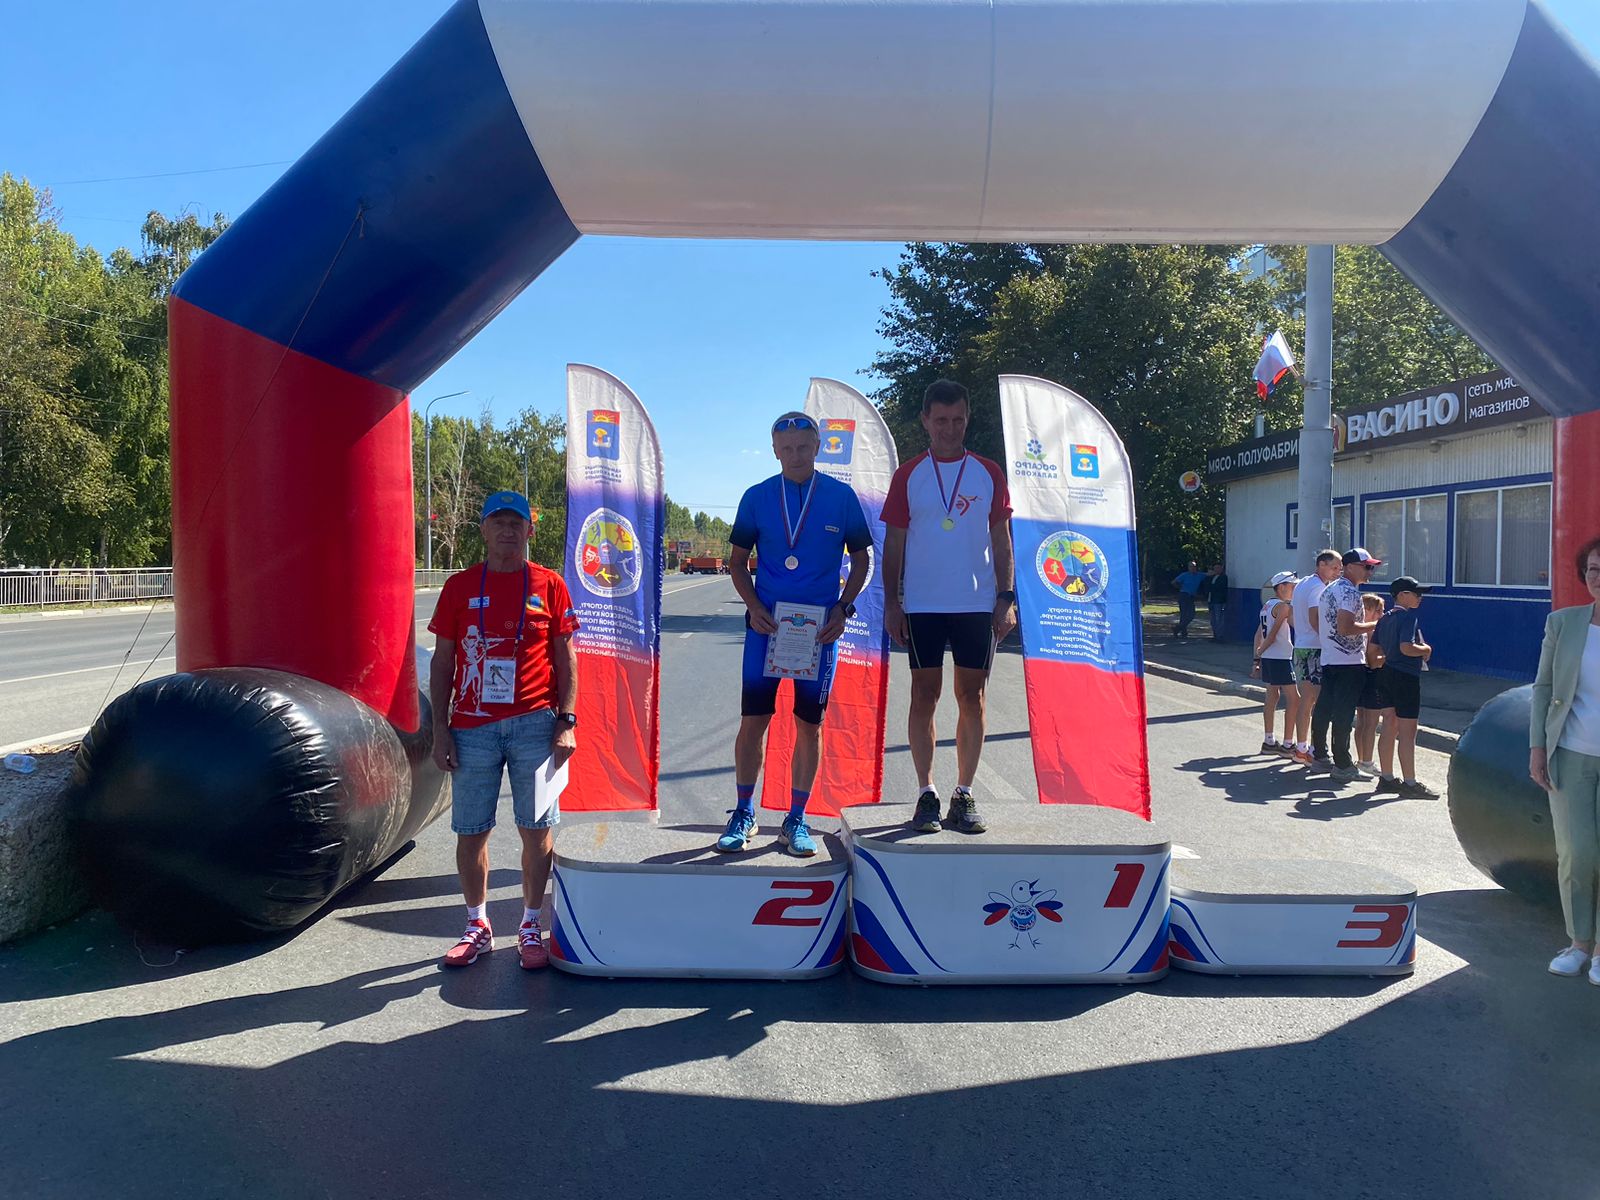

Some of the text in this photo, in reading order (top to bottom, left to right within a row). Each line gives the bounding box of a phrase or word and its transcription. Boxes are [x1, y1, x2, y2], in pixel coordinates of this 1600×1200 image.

[1468, 377, 1519, 398] сеть мяс
[1468, 396, 1530, 420] магазинов
[1347, 392, 1460, 444] ВАСИНО
[1208, 438, 1300, 474] МЯСО ПОЛУФАБРИ
[752, 880, 834, 927] 2
[1104, 863, 1145, 908] 1
[1336, 904, 1409, 948] 3
